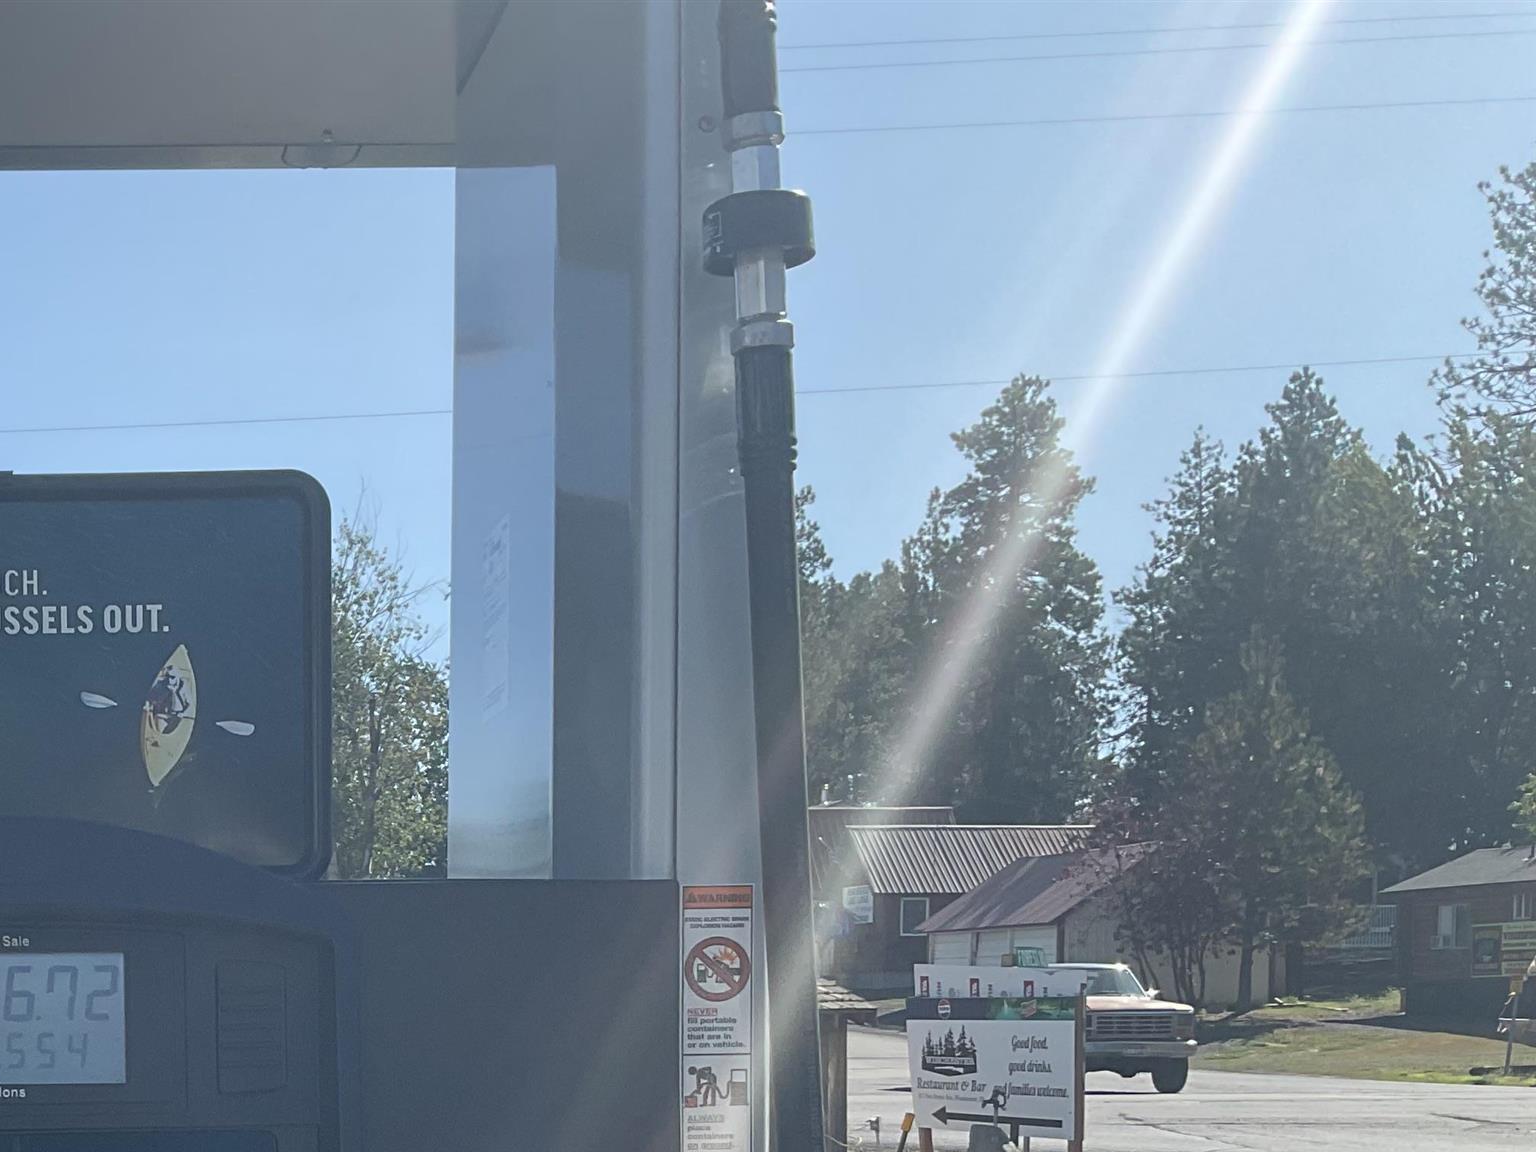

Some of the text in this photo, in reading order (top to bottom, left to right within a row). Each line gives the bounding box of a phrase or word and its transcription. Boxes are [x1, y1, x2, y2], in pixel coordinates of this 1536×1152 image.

[103, 604, 170, 634] OUT.
[2, 935, 30, 947] Sale
[1011, 1034, 1030, 1052] Good
[1008, 1061, 1026, 1075] good
[916, 1077, 987, 1092] Restaurant & Bar
